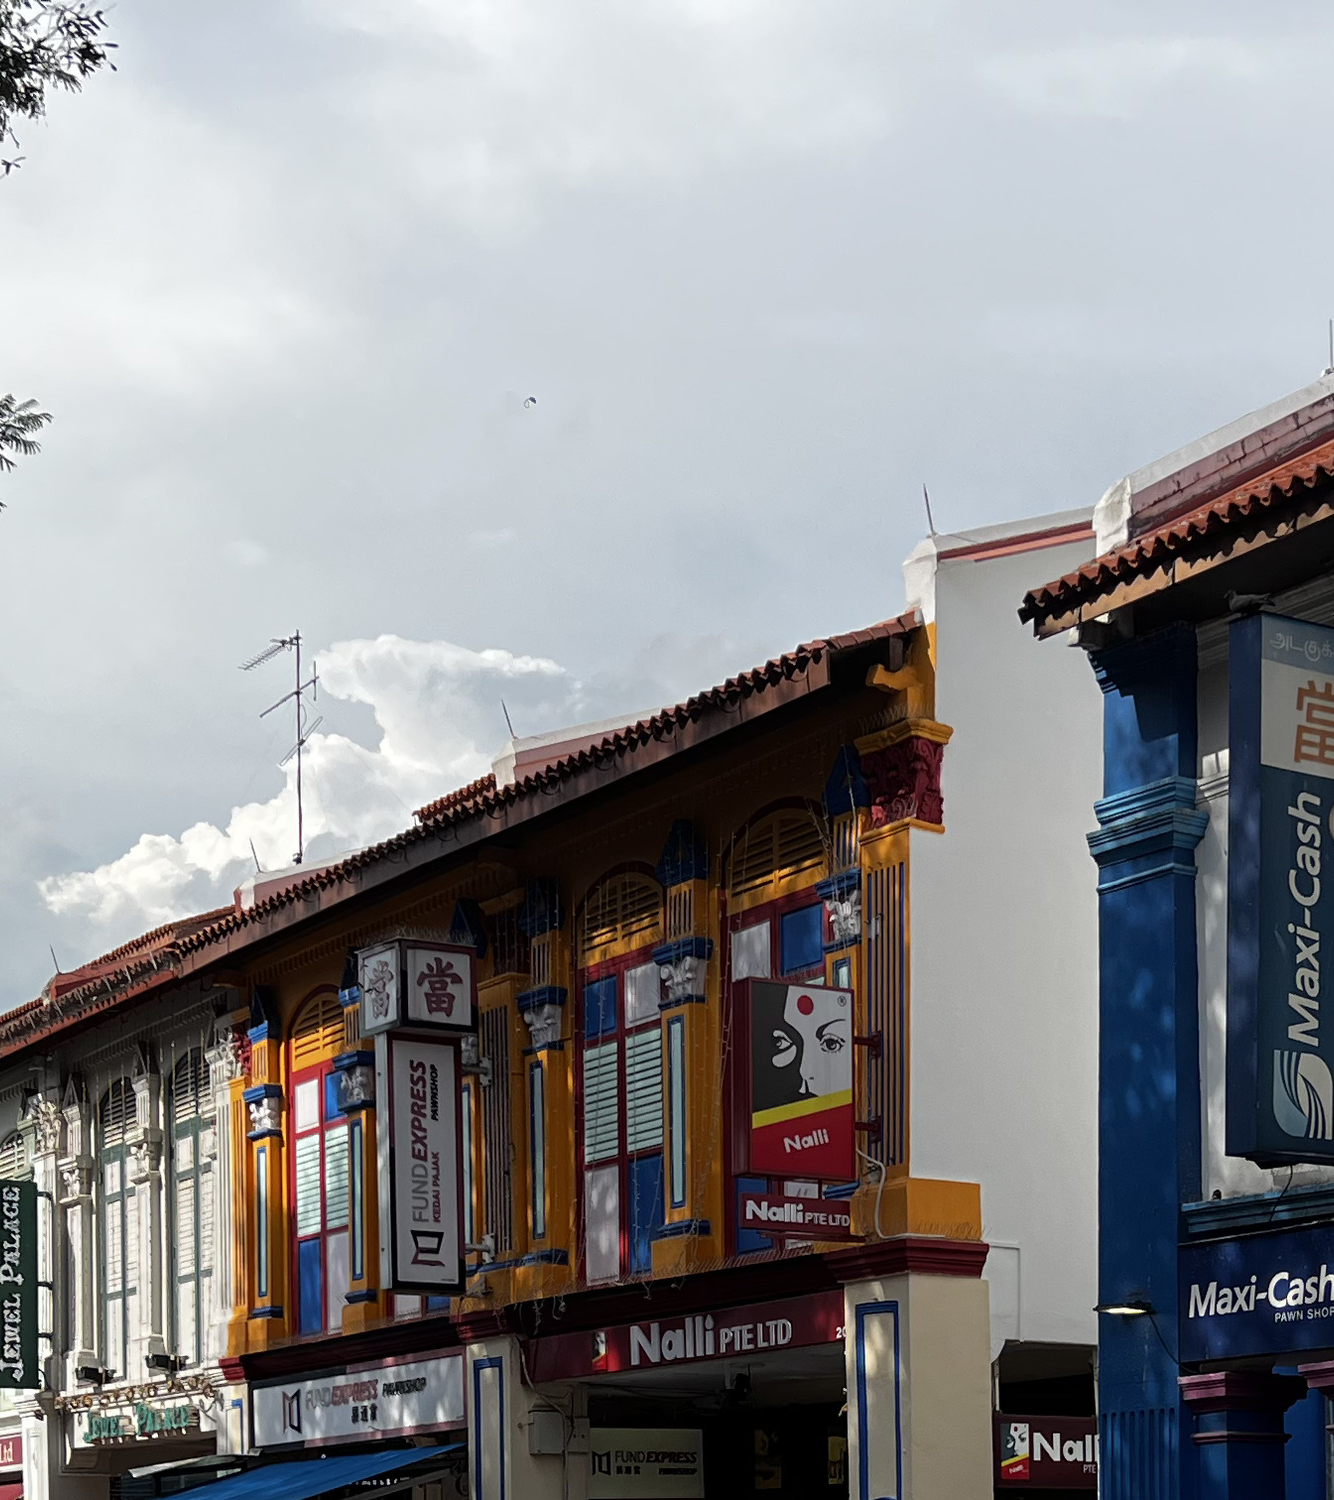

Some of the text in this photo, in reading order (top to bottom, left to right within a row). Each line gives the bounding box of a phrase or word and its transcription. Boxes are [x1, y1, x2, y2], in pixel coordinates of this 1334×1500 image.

[1287, 789, 1322, 1047] Maxi-Cash
[417, 957, 464, 1018] 當
[430, 1064, 440, 1121] PAWNSHOP
[783, 1128, 829, 1153] Nalli
[432, 1151, 441, 1223] KEDAI PAJAK
[746, 1200, 851, 1227] Nalli PTE LTD
[630, 1314, 792, 1366] Nalli PTE LTD
[1274, 1309, 1304, 1323] PAWN
[1033, 1432, 1100, 1462] Nall
